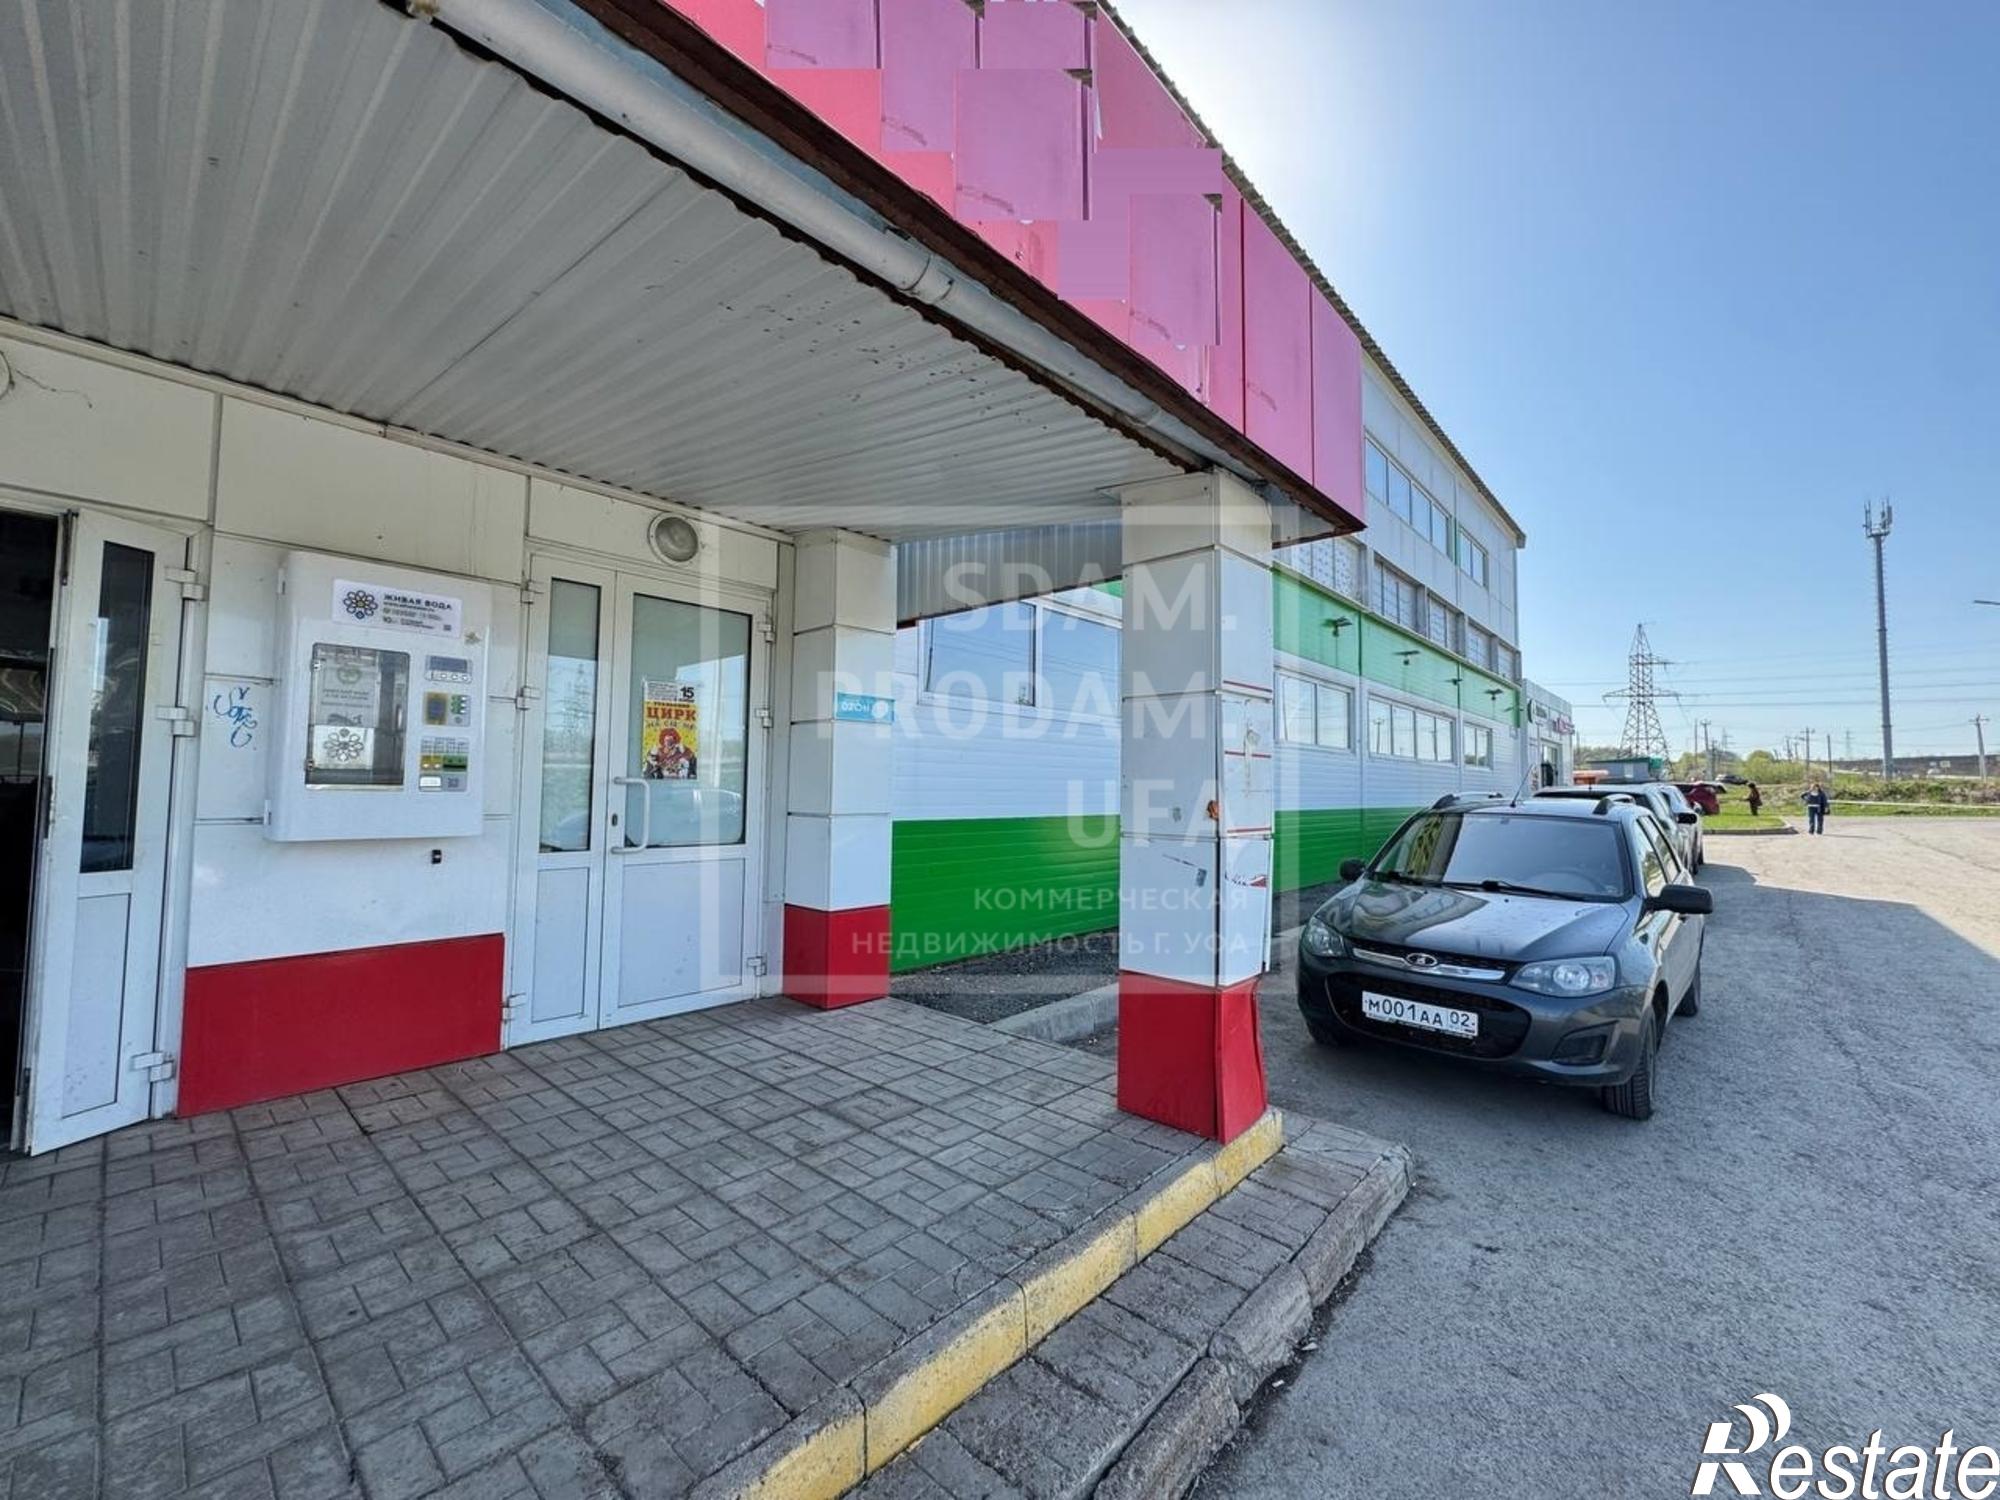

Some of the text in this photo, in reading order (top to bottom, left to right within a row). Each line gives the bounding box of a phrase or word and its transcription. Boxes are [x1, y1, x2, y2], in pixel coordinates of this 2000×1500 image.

[383, 594, 422, 605] ЖИВАЯ
[424, 600, 453, 611] ВОДА
[680, 686, 695, 699] 15
[646, 706, 697, 721] ЦИРК
